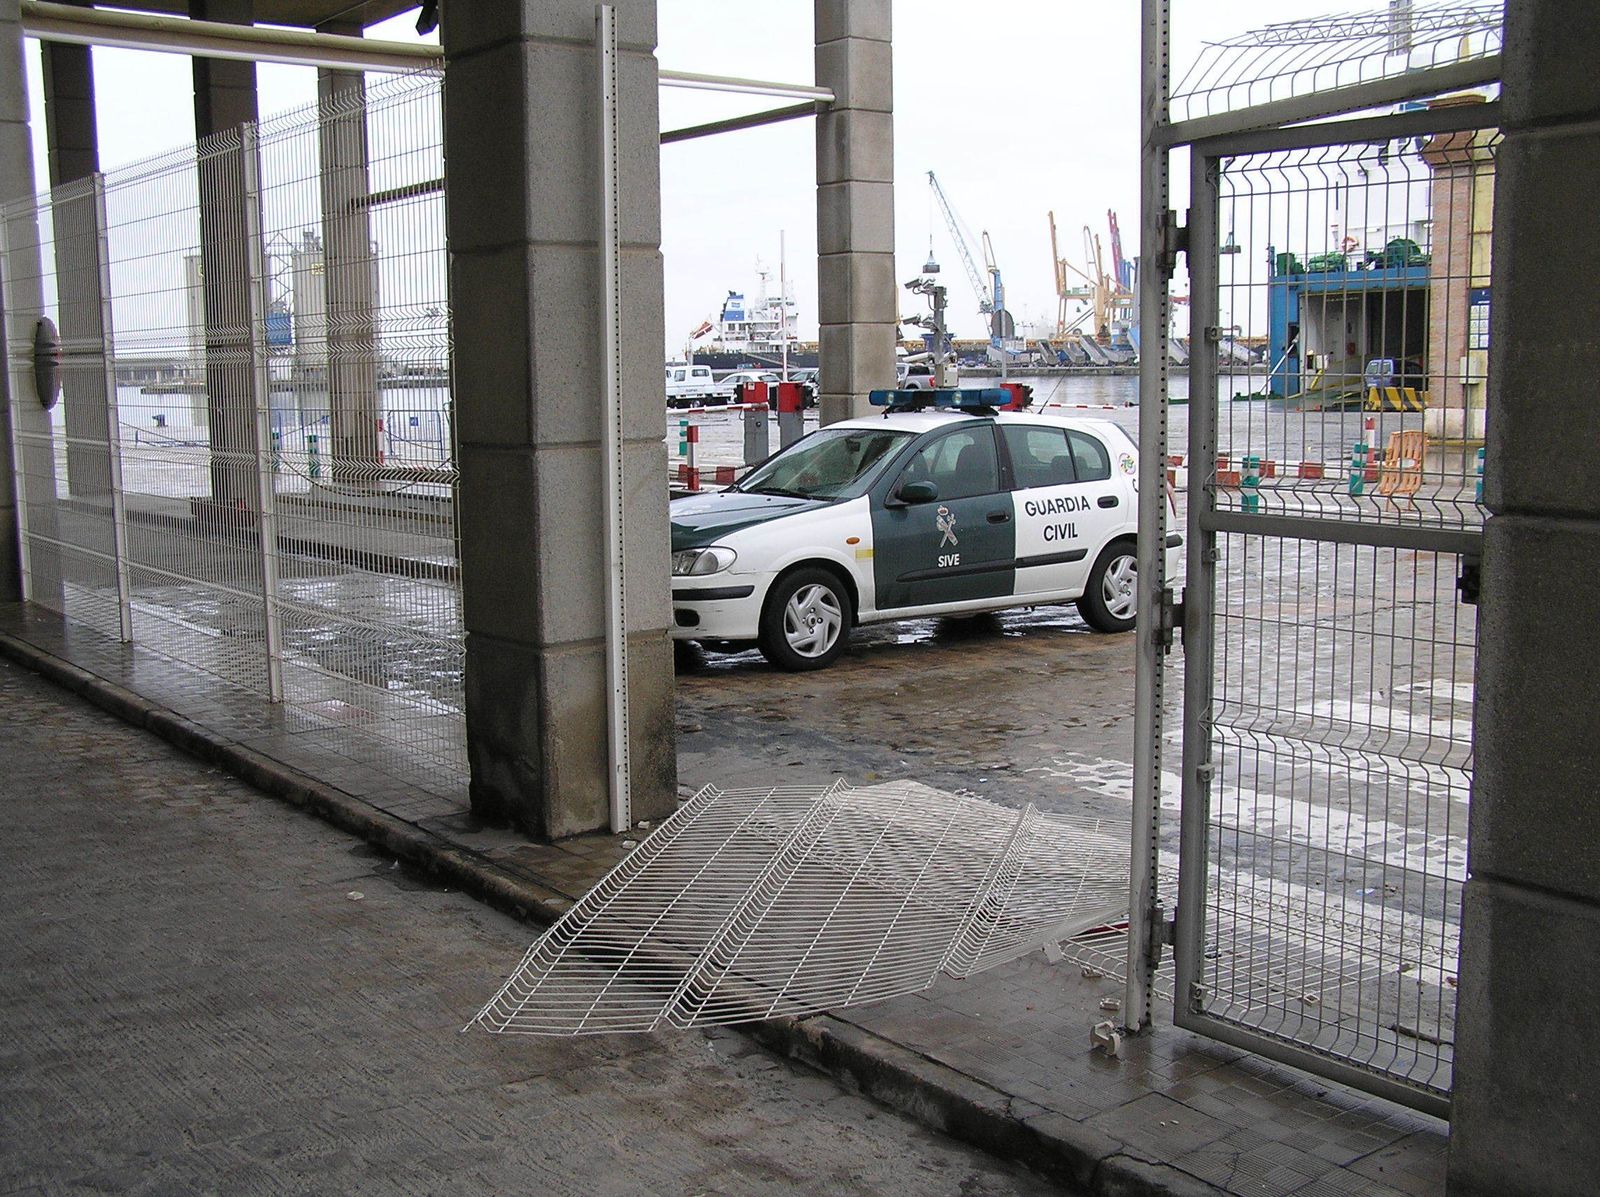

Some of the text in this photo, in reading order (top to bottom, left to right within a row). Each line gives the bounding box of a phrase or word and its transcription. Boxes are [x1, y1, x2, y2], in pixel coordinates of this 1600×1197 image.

[1025, 495, 1091, 517] GUARDIA
[1043, 522, 1078, 542] CIVIL
[937, 553, 960, 568] SIVE
